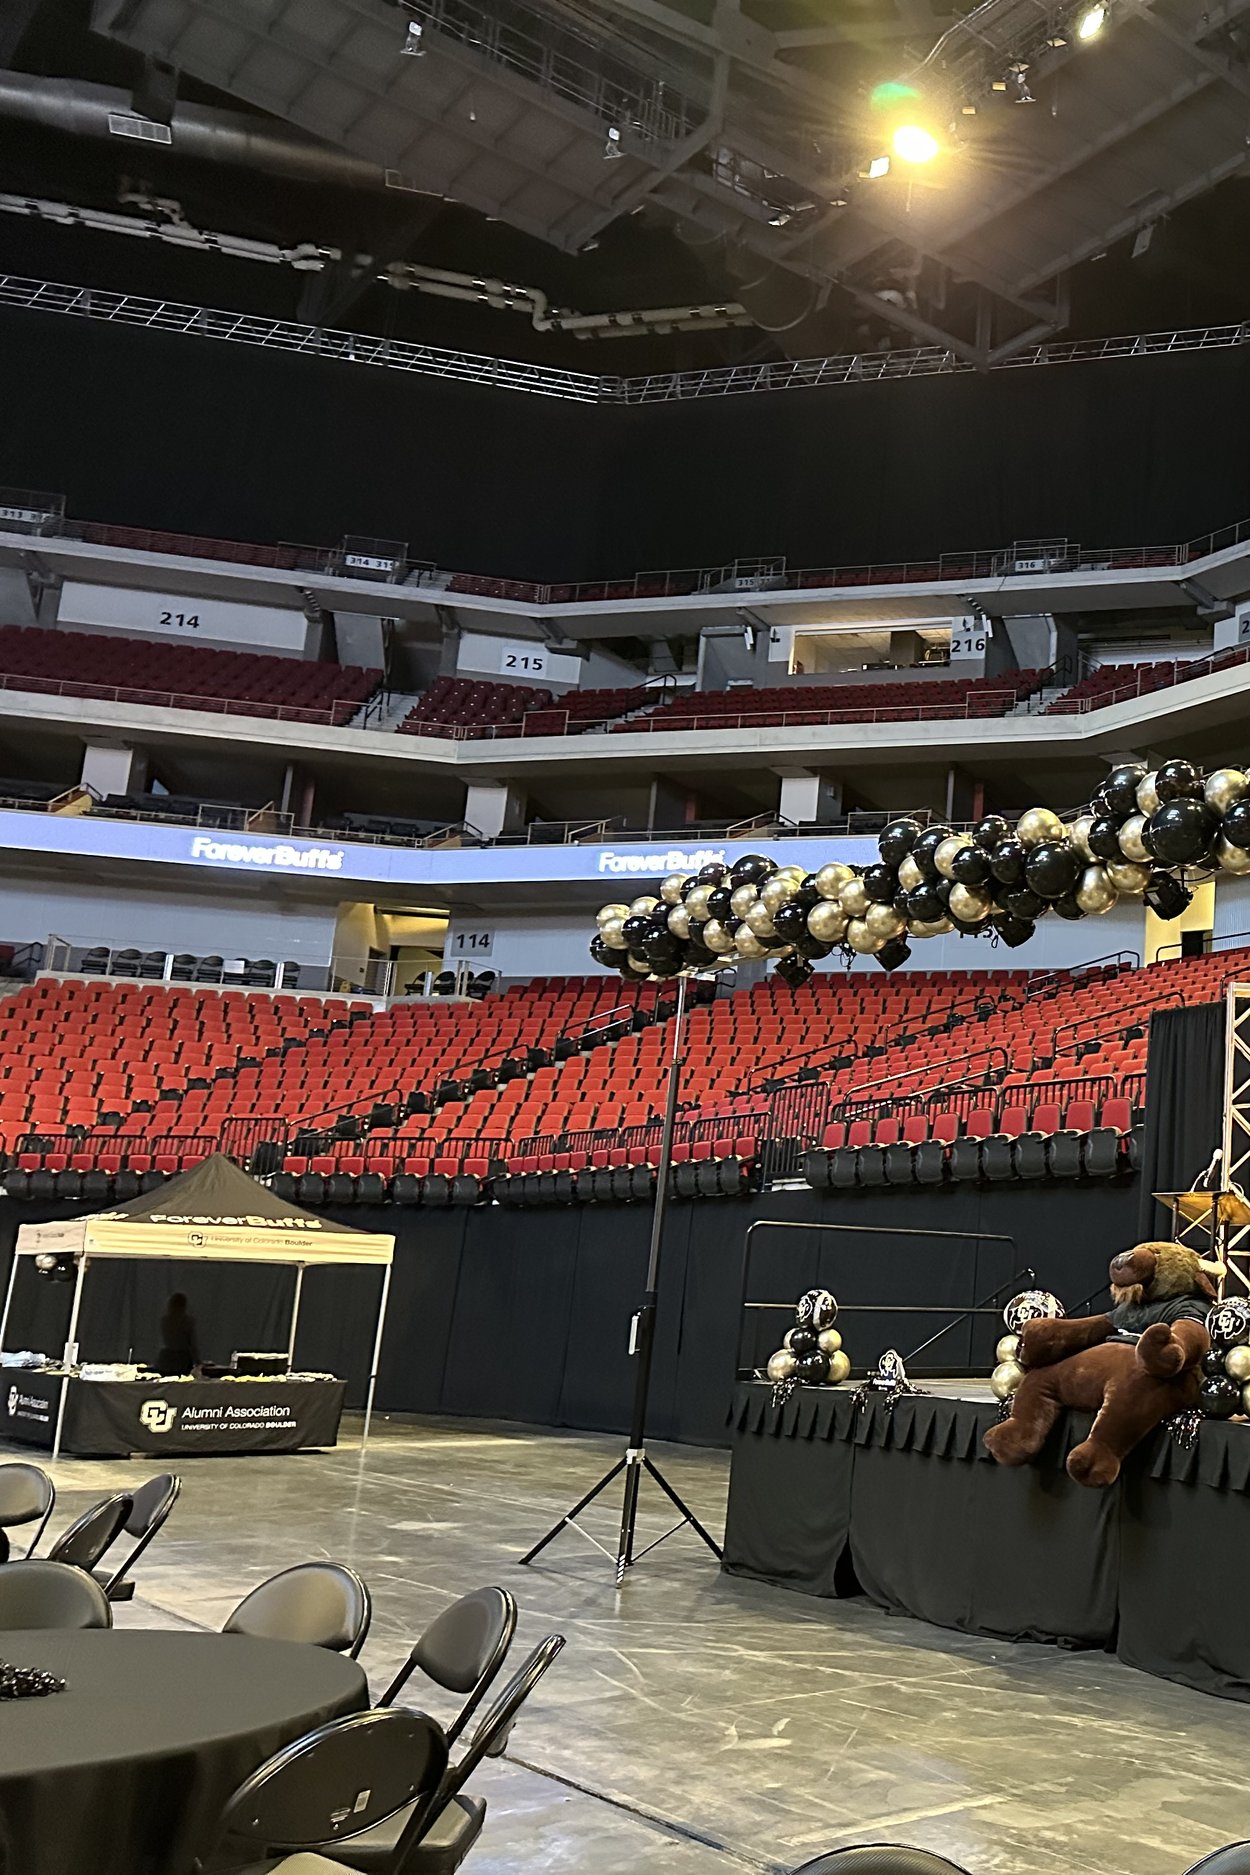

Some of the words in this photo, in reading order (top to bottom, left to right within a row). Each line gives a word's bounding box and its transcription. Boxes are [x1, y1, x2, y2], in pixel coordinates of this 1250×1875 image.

[350, 557, 369, 566] 314
[160, 611, 200, 629] 214
[951, 638, 985, 653] 216
[506, 654, 543, 671] 215
[191, 837, 344, 870] ForeverBuffs
[457, 933, 490, 949] 114
[181, 1406, 223, 1419] Alumni
[224, 1405, 291, 1418] Association
[181, 1423, 218, 1431] UNIVERSITY
[229, 1422, 264, 1430] COLORADO
